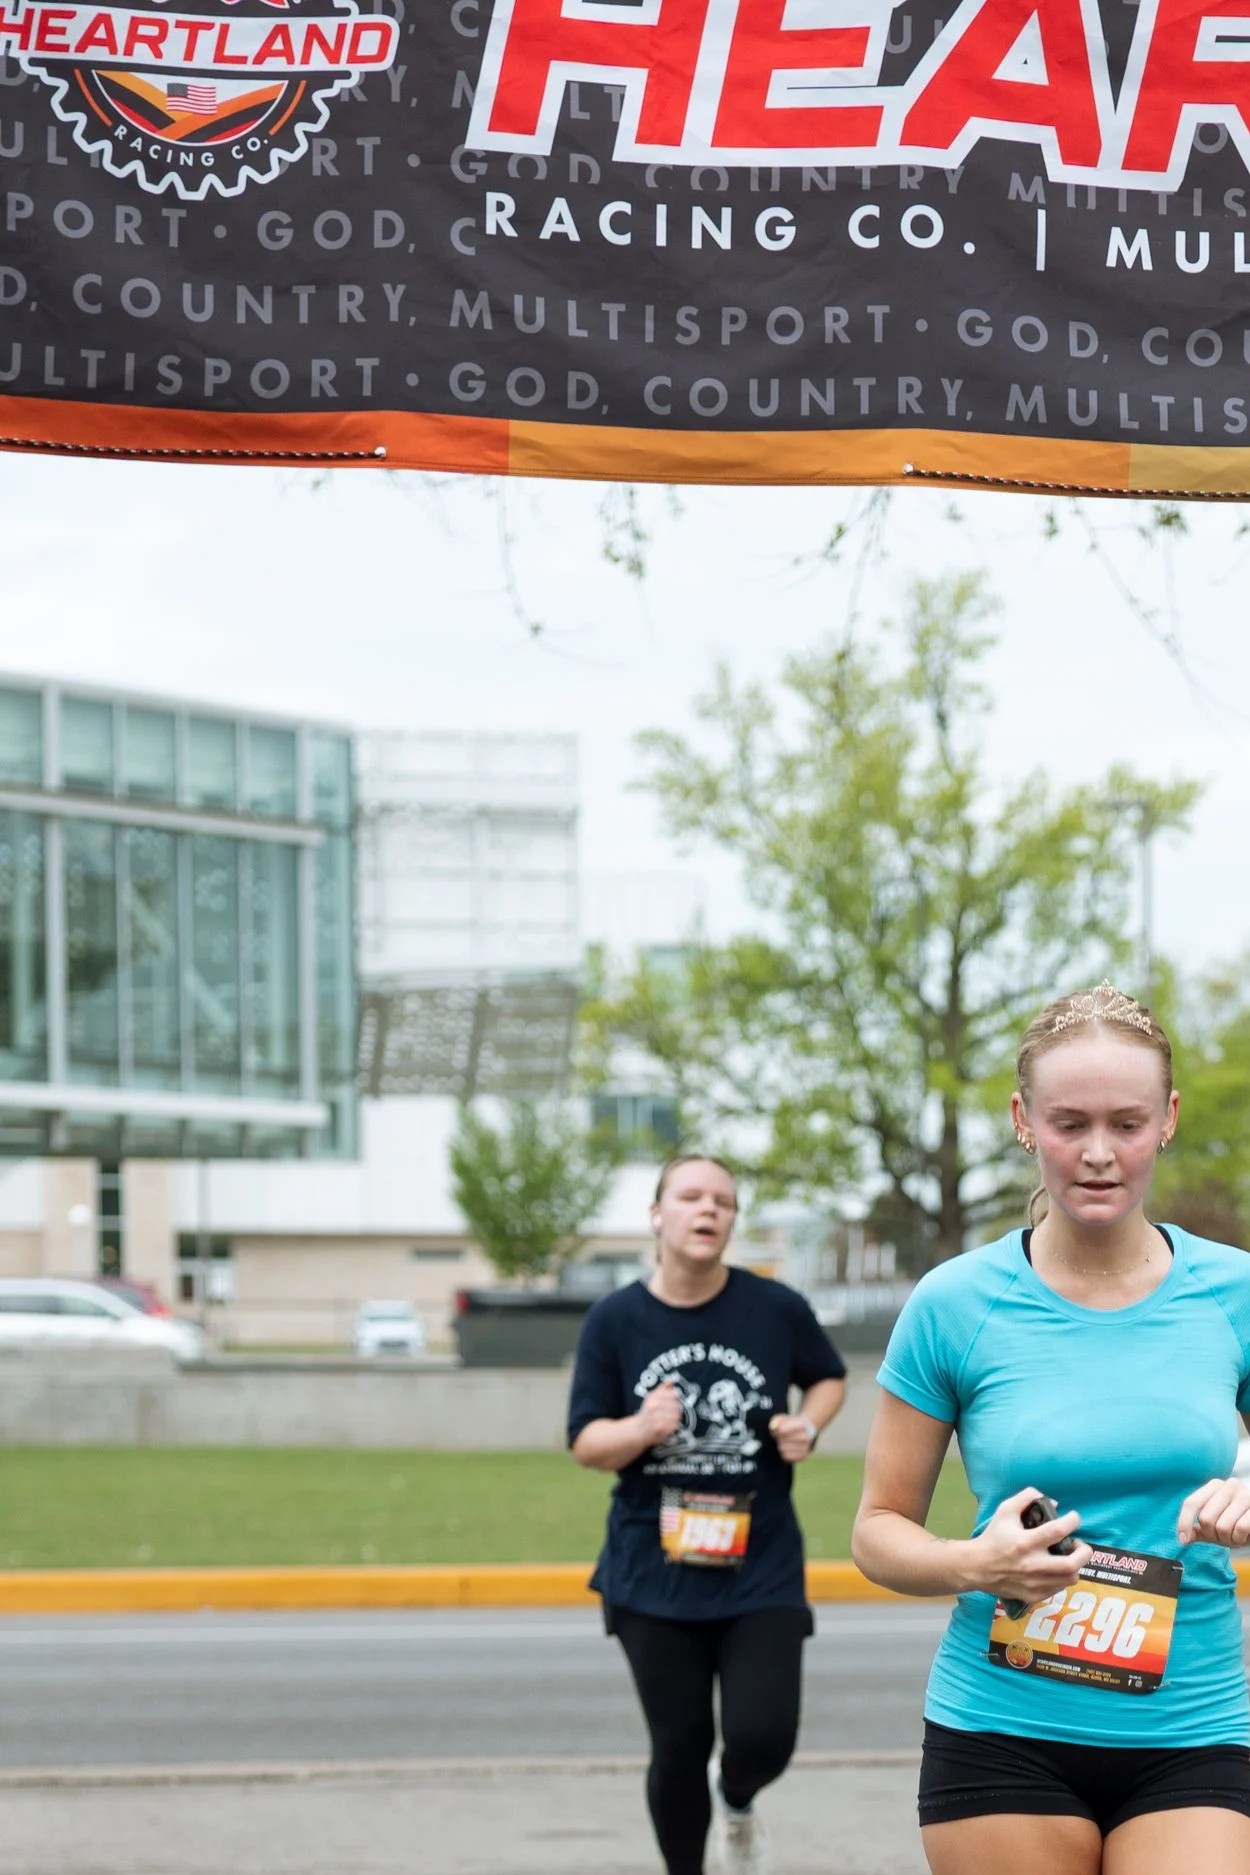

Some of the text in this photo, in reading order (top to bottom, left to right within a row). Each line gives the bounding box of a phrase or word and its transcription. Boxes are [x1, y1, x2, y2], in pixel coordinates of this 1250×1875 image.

[0, 5, 393, 66] HEARTLAND
[114, 124, 216, 168] RACING
[231, 136, 270, 161] CO.
[257, 209, 415, 254] GOD,
[484, 190, 798, 253] RACING
[847, 203, 977, 256] CO.
[73, 272, 416, 328] COUNTRY,
[449, 288, 890, 347] MULTISPORT
[957, 307, 1109, 364] GOD,
[449, 361, 609, 415] GOD,
[644, 374, 973, 422] COUNTRY,
[1024, 1588, 1155, 1659] 2296
